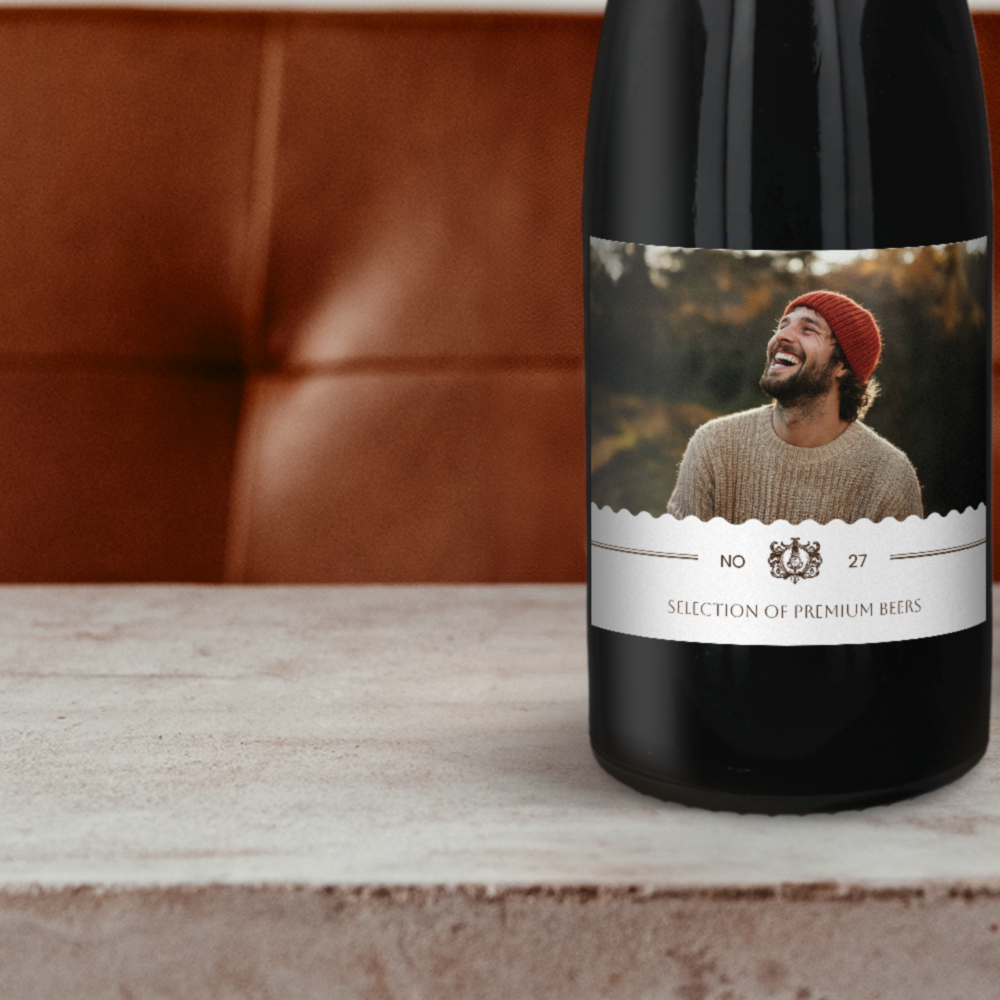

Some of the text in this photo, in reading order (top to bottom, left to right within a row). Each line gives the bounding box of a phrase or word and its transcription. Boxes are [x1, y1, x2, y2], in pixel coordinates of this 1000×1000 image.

[720, 553, 868, 569] NO 27
[667, 598, 923, 619] SELECTION OF PREMIUM BEERS
